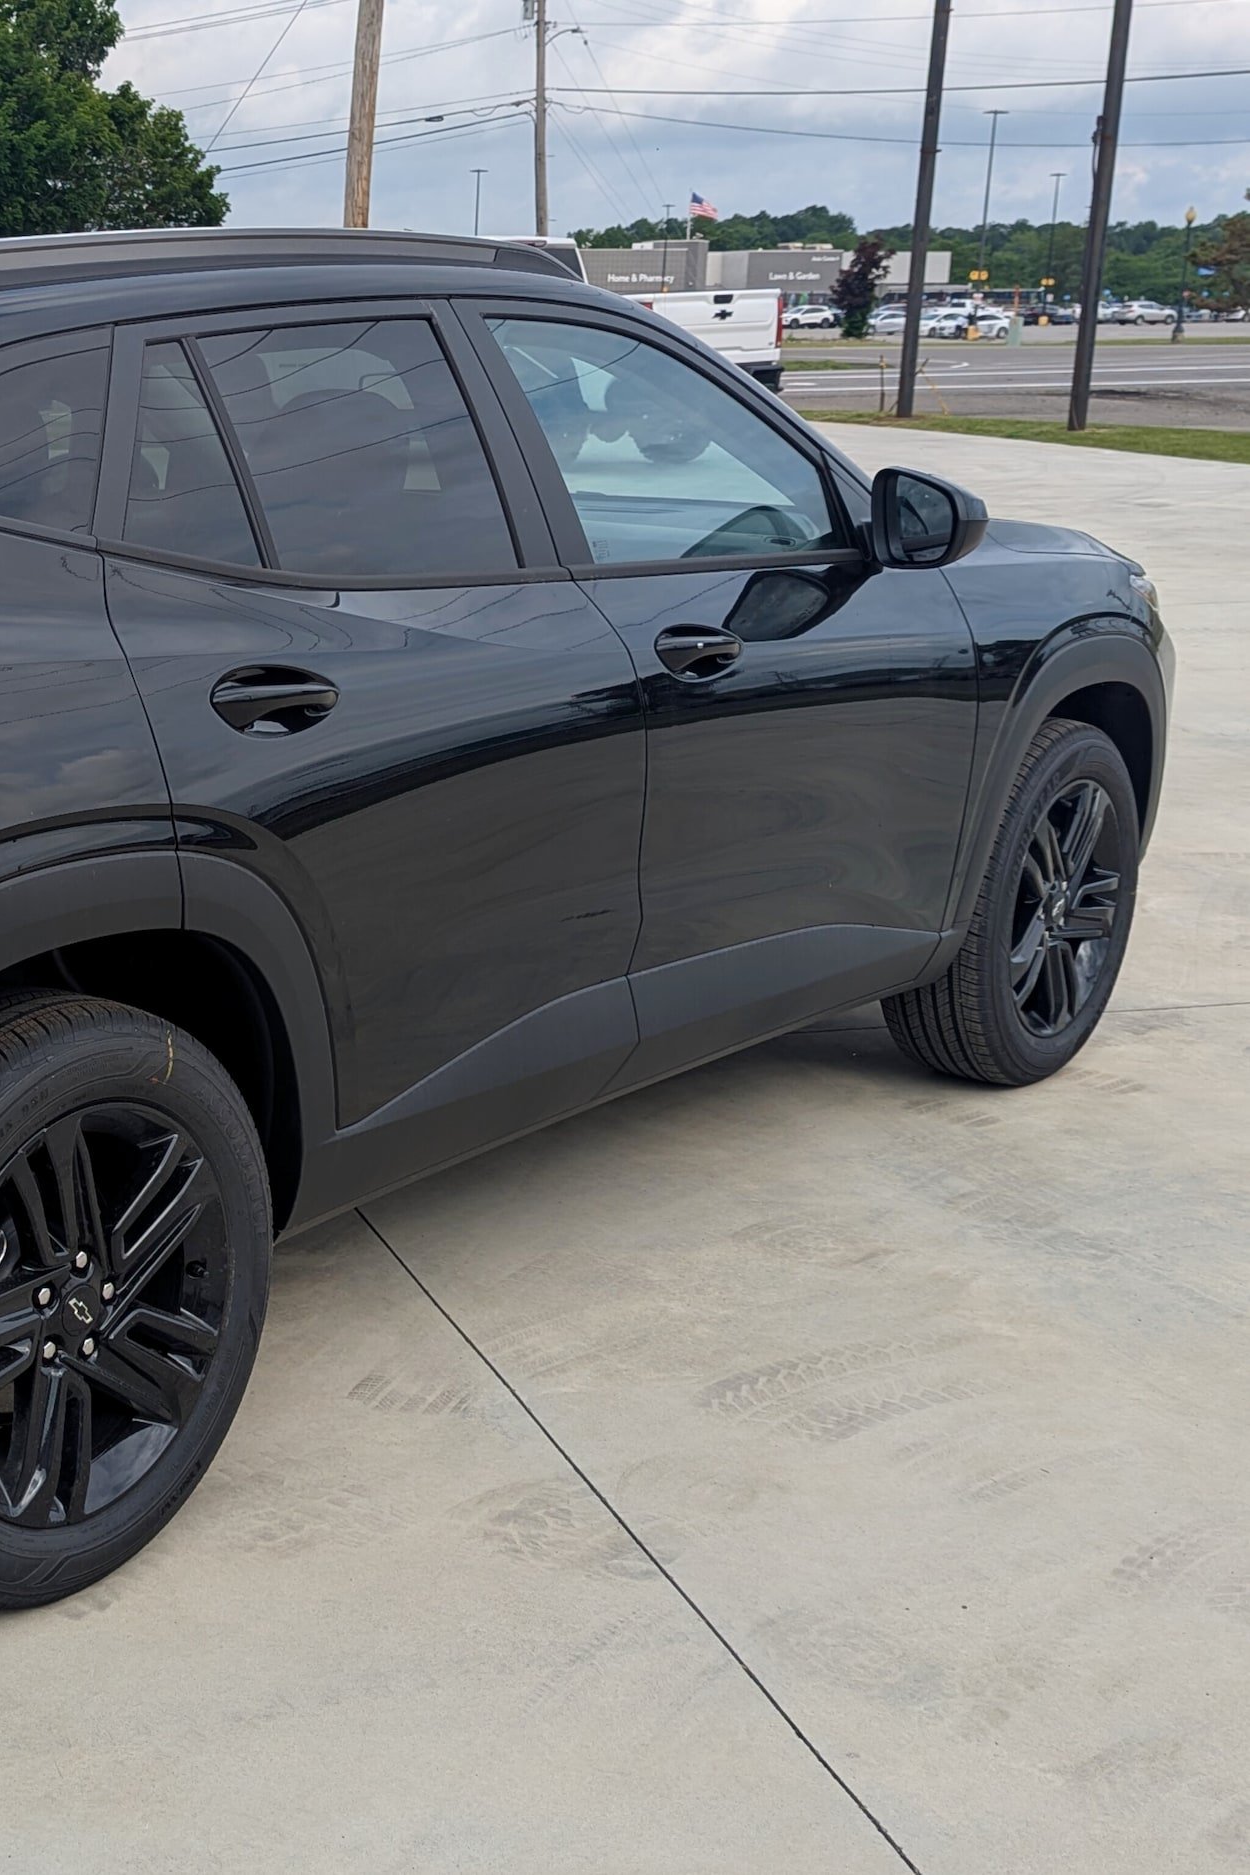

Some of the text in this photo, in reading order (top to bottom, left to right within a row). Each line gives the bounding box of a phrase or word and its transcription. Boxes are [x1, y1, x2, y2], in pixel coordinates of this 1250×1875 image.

[607, 273, 630, 283] Home
[631, 273, 638, 283] &
[768, 271, 821, 281] Lawn & Garden
